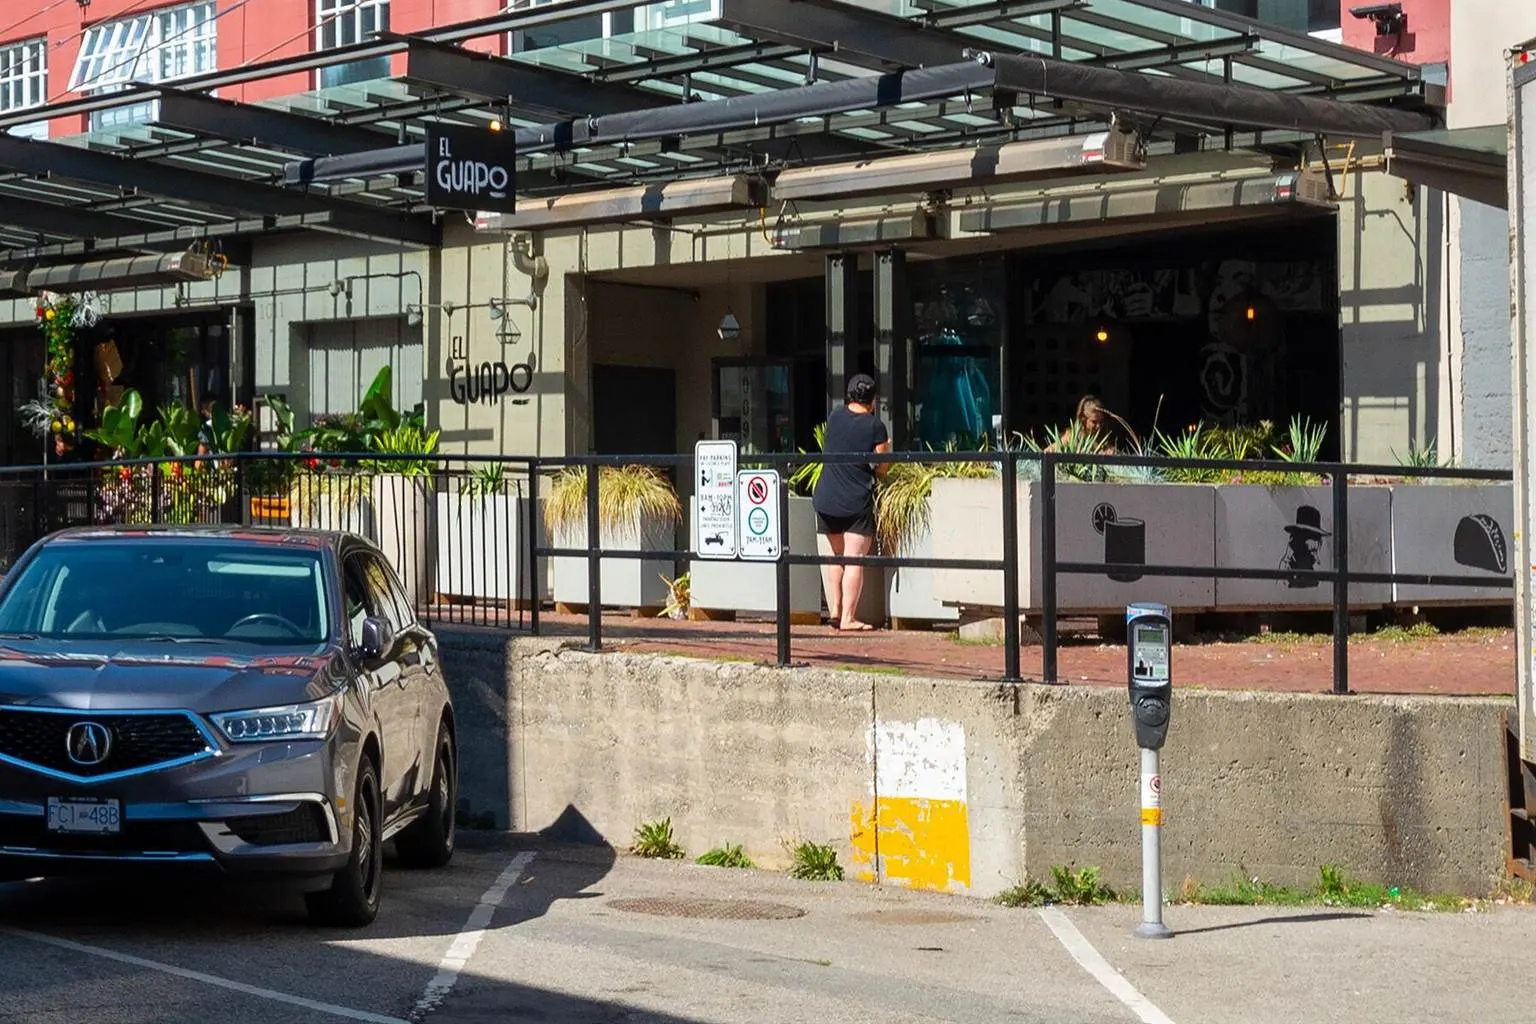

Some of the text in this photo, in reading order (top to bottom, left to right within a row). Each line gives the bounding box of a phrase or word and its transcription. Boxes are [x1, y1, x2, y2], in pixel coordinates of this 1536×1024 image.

[439, 136, 452, 159] EL
[436, 159, 509, 199] GUAPO
[452, 335, 467, 360] EL
[450, 361, 533, 407] GUAPO
